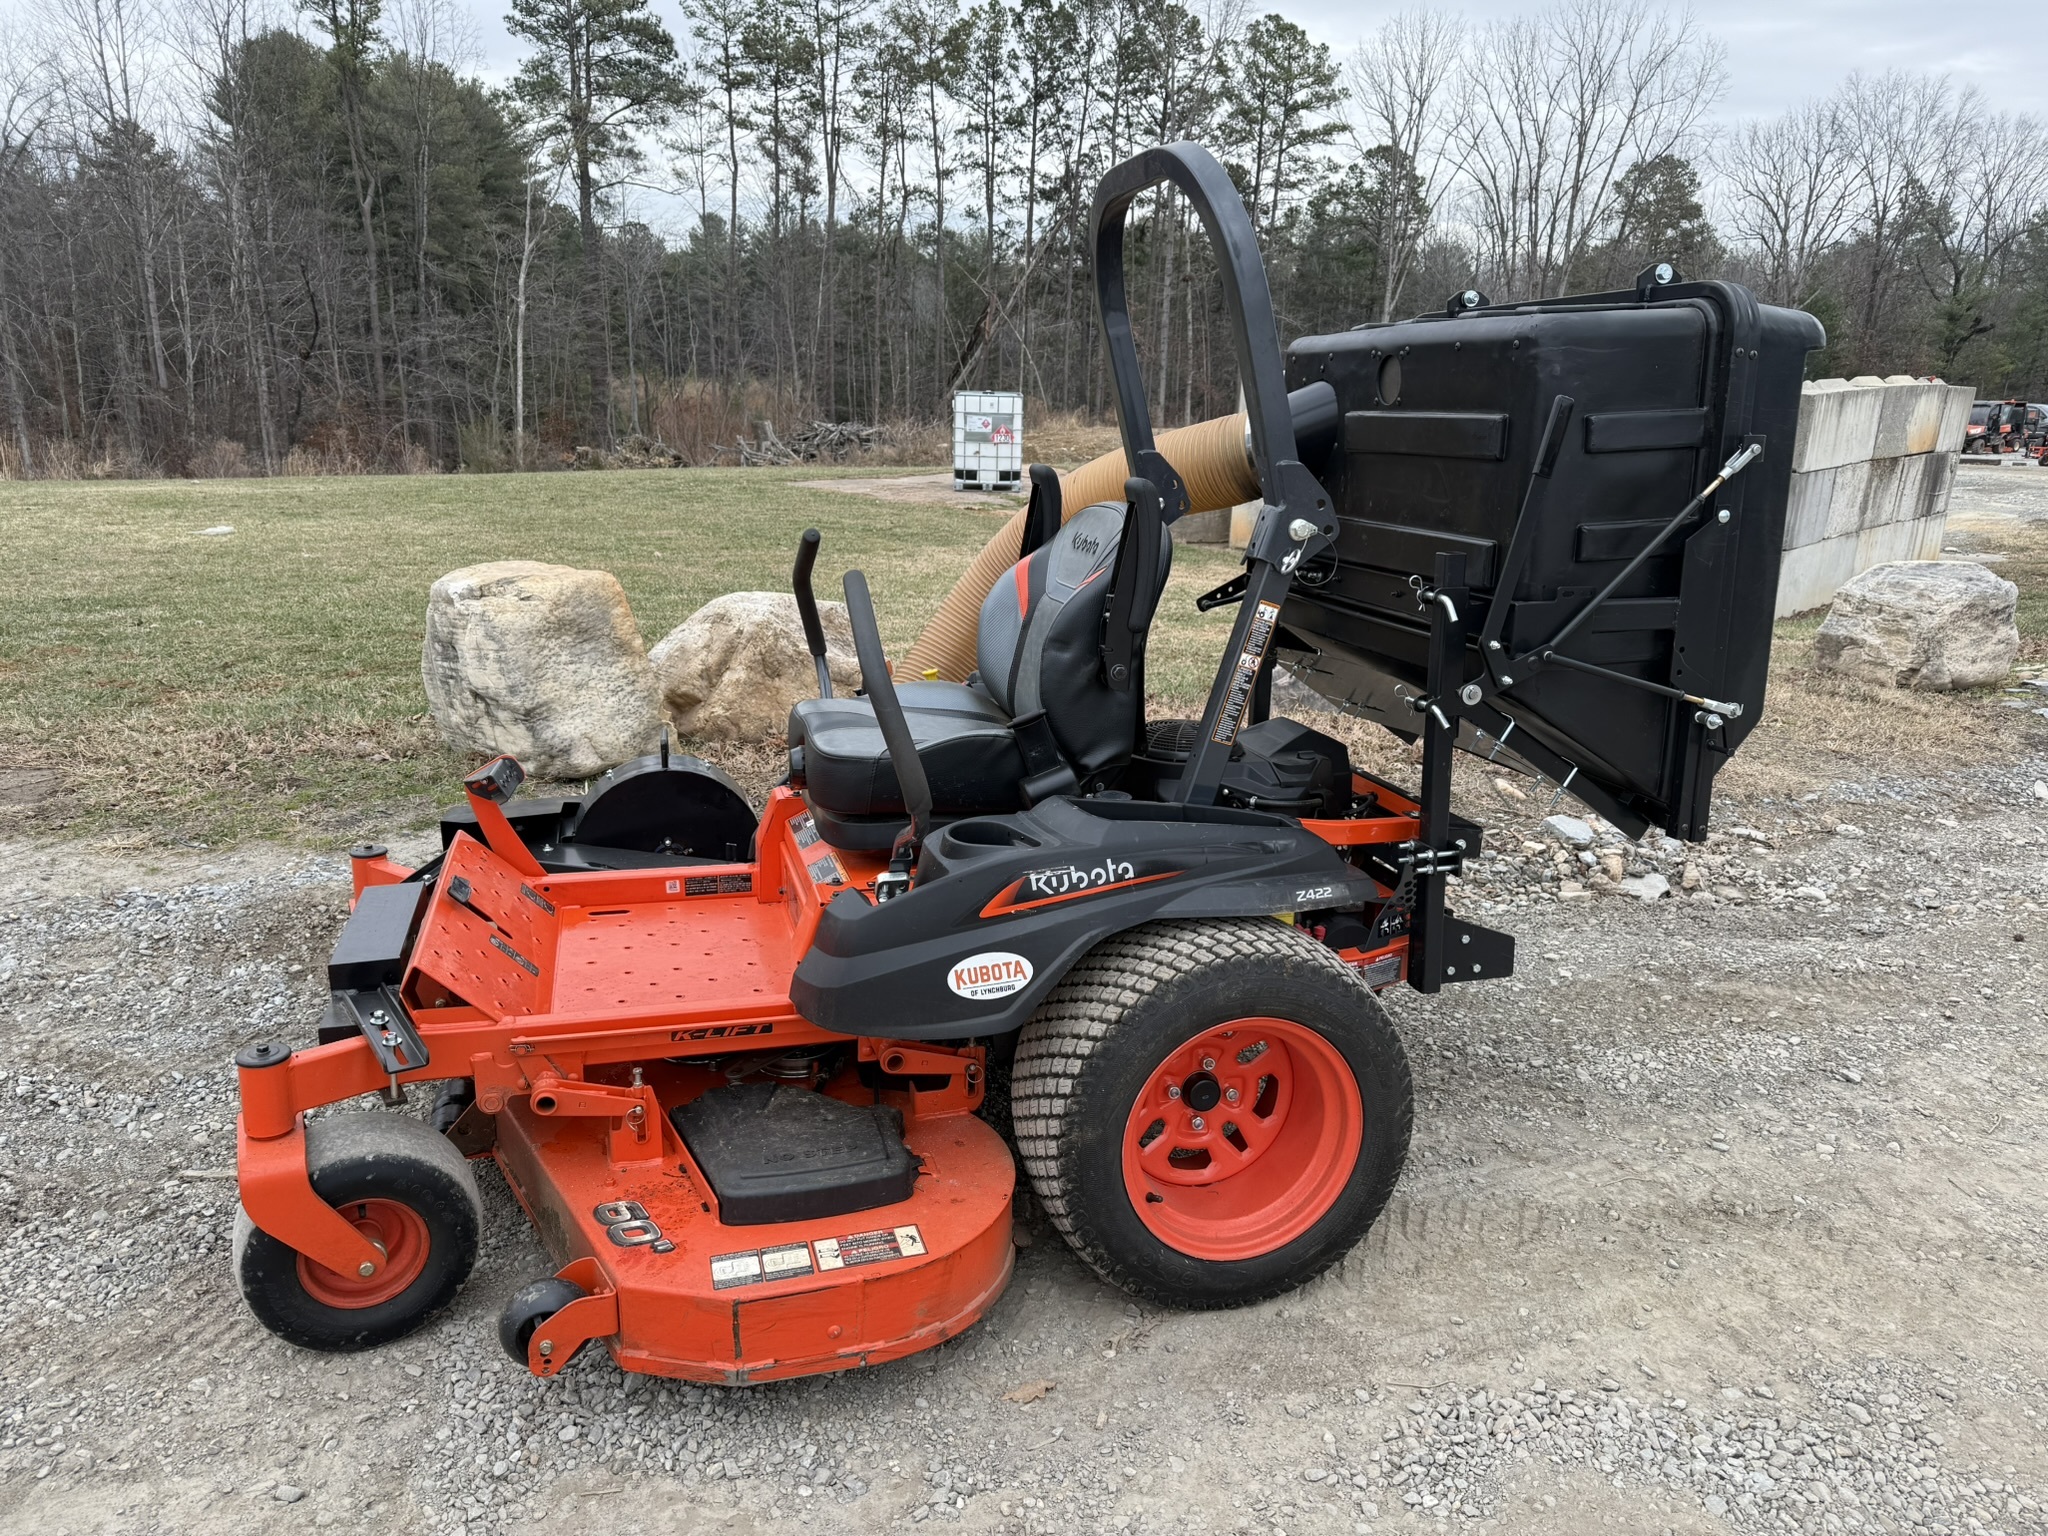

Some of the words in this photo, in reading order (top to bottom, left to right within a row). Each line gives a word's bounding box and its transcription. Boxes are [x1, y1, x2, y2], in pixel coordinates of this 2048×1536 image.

[1073, 531, 1100, 555] Kubota
[1029, 858, 1135, 895] Kubota
[1296, 886, 1333, 902] Z422
[954, 960, 1028, 990] KUBOTA
[970, 988, 979, 997] OF
[980, 984, 1016, 996] LYNCHBURG
[673, 1024, 770, 1041] K-LIFT
[762, 1152, 795, 1165] NO
[803, 1142, 859, 1160] STEP
